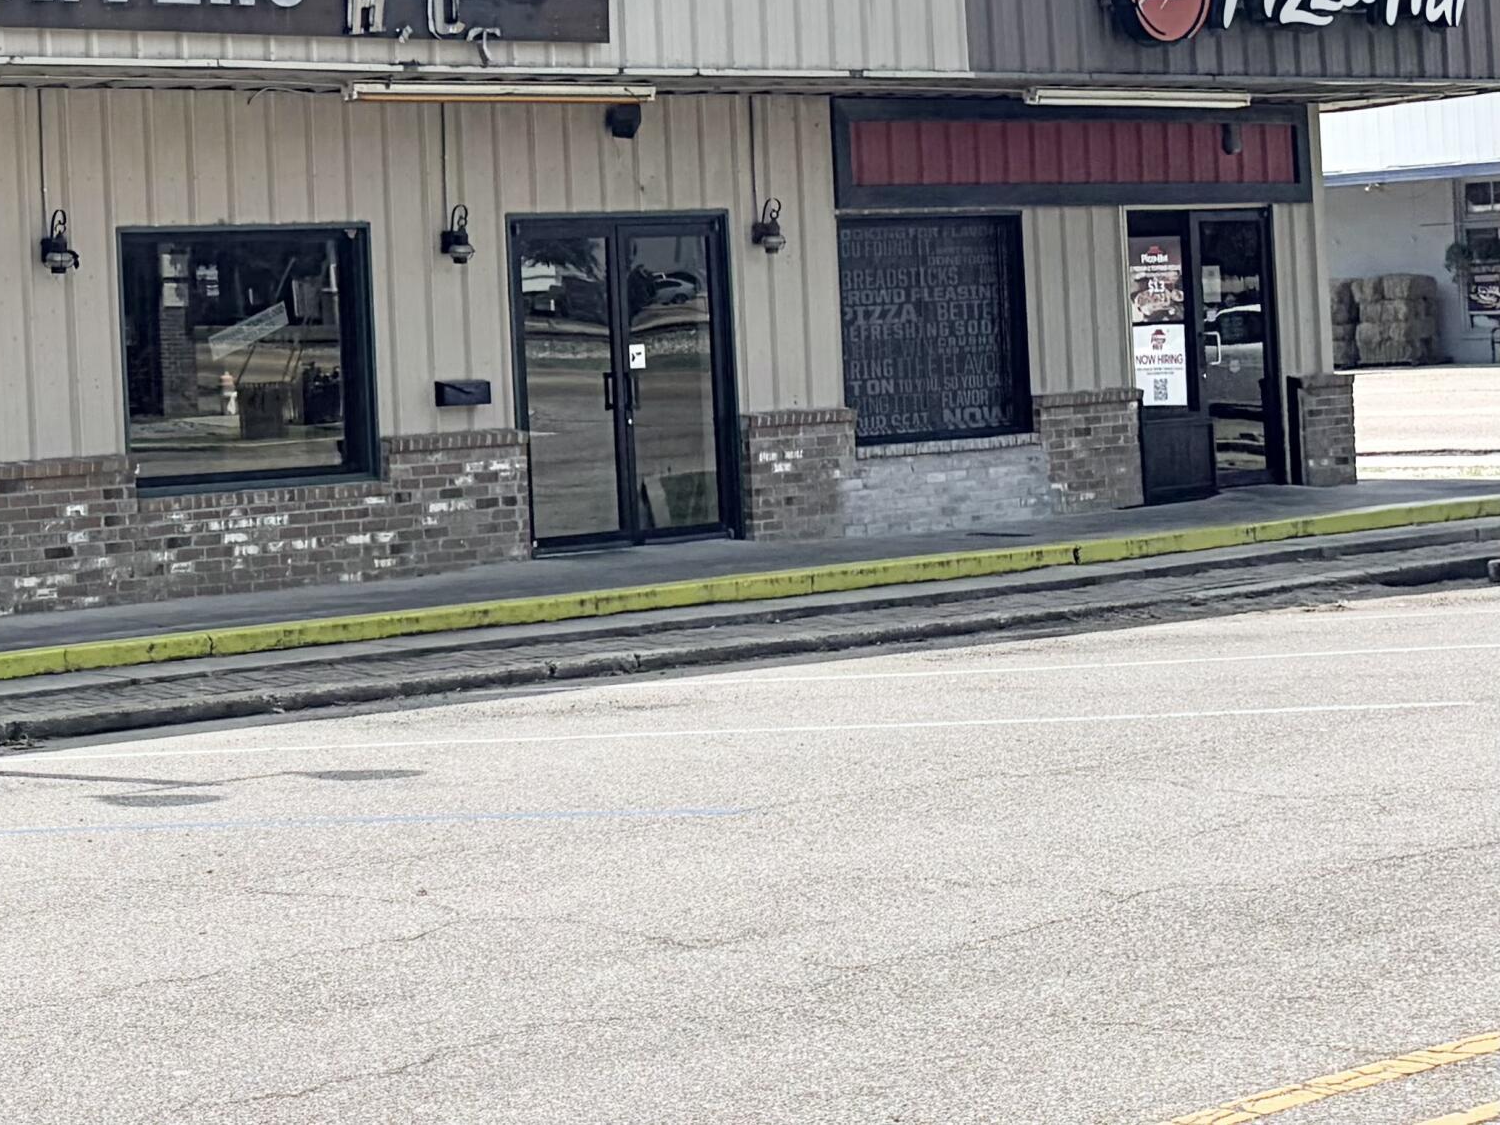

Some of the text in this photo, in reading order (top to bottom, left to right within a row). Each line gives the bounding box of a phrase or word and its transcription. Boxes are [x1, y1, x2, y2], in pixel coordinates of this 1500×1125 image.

[842, 266, 959, 290] BREADSTICKS
[1136, 353, 1183, 365] NOW HIRING
